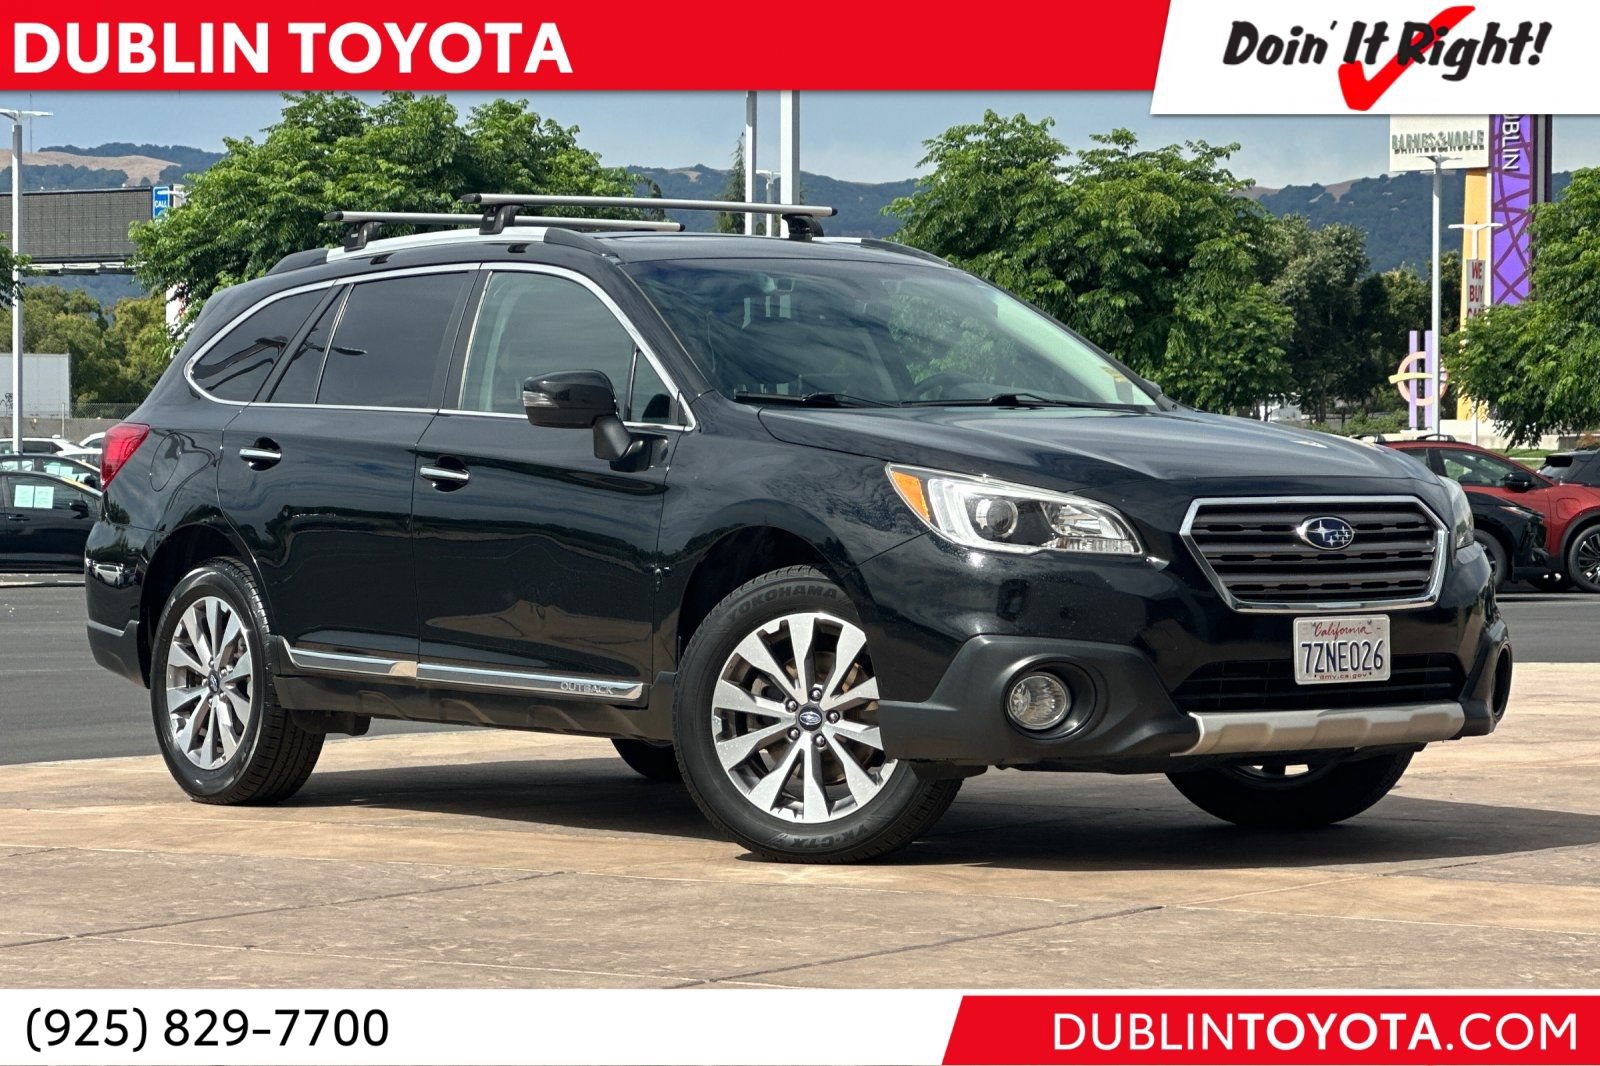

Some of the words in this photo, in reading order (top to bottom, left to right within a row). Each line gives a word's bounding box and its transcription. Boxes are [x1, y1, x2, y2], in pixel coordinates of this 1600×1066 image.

[1471, 261, 1483, 280] WE
[1469, 284, 1484, 302] BUY
[725, 584, 838, 622] YOKOHAMA
[1314, 621, 1373, 640] California
[1301, 639, 1384, 674] 7ZNE026
[560, 681, 614, 695] OUTBACK
